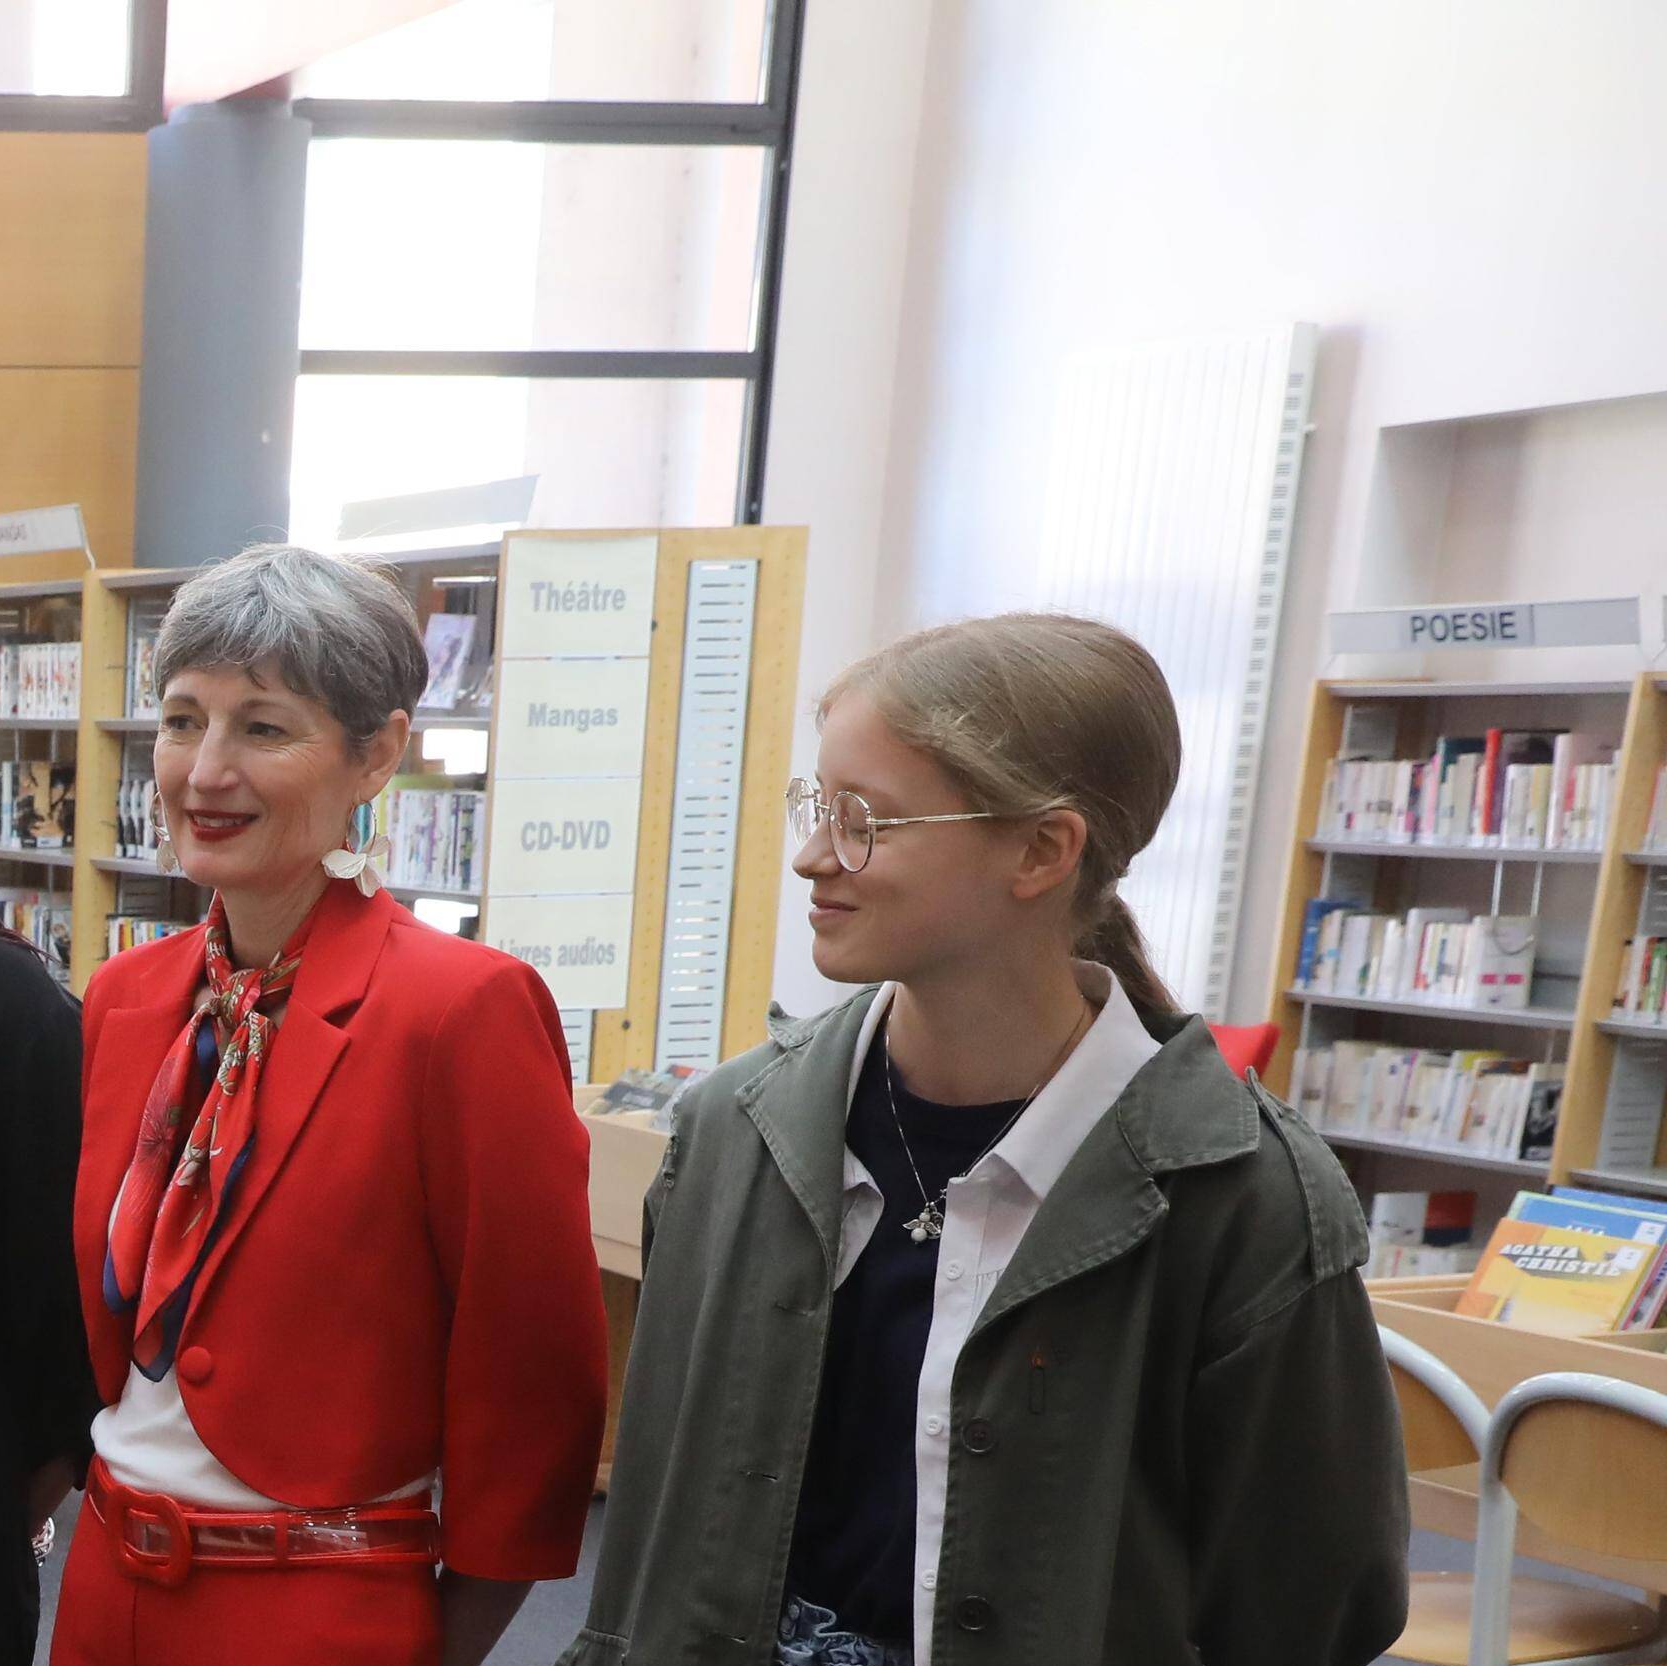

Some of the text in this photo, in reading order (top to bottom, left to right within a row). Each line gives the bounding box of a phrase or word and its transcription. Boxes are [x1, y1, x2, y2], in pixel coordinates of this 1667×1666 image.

[530, 580, 627, 613] Théâtre
[1409, 611, 1518, 643] POESIE
[526, 702, 618, 733] Mangas
[521, 820, 611, 851] CD-DVD
[556, 936, 616, 967] audios
[1499, 1243, 1581, 1260] AGATHA
[1514, 1256, 1623, 1278] CHRISTIE
